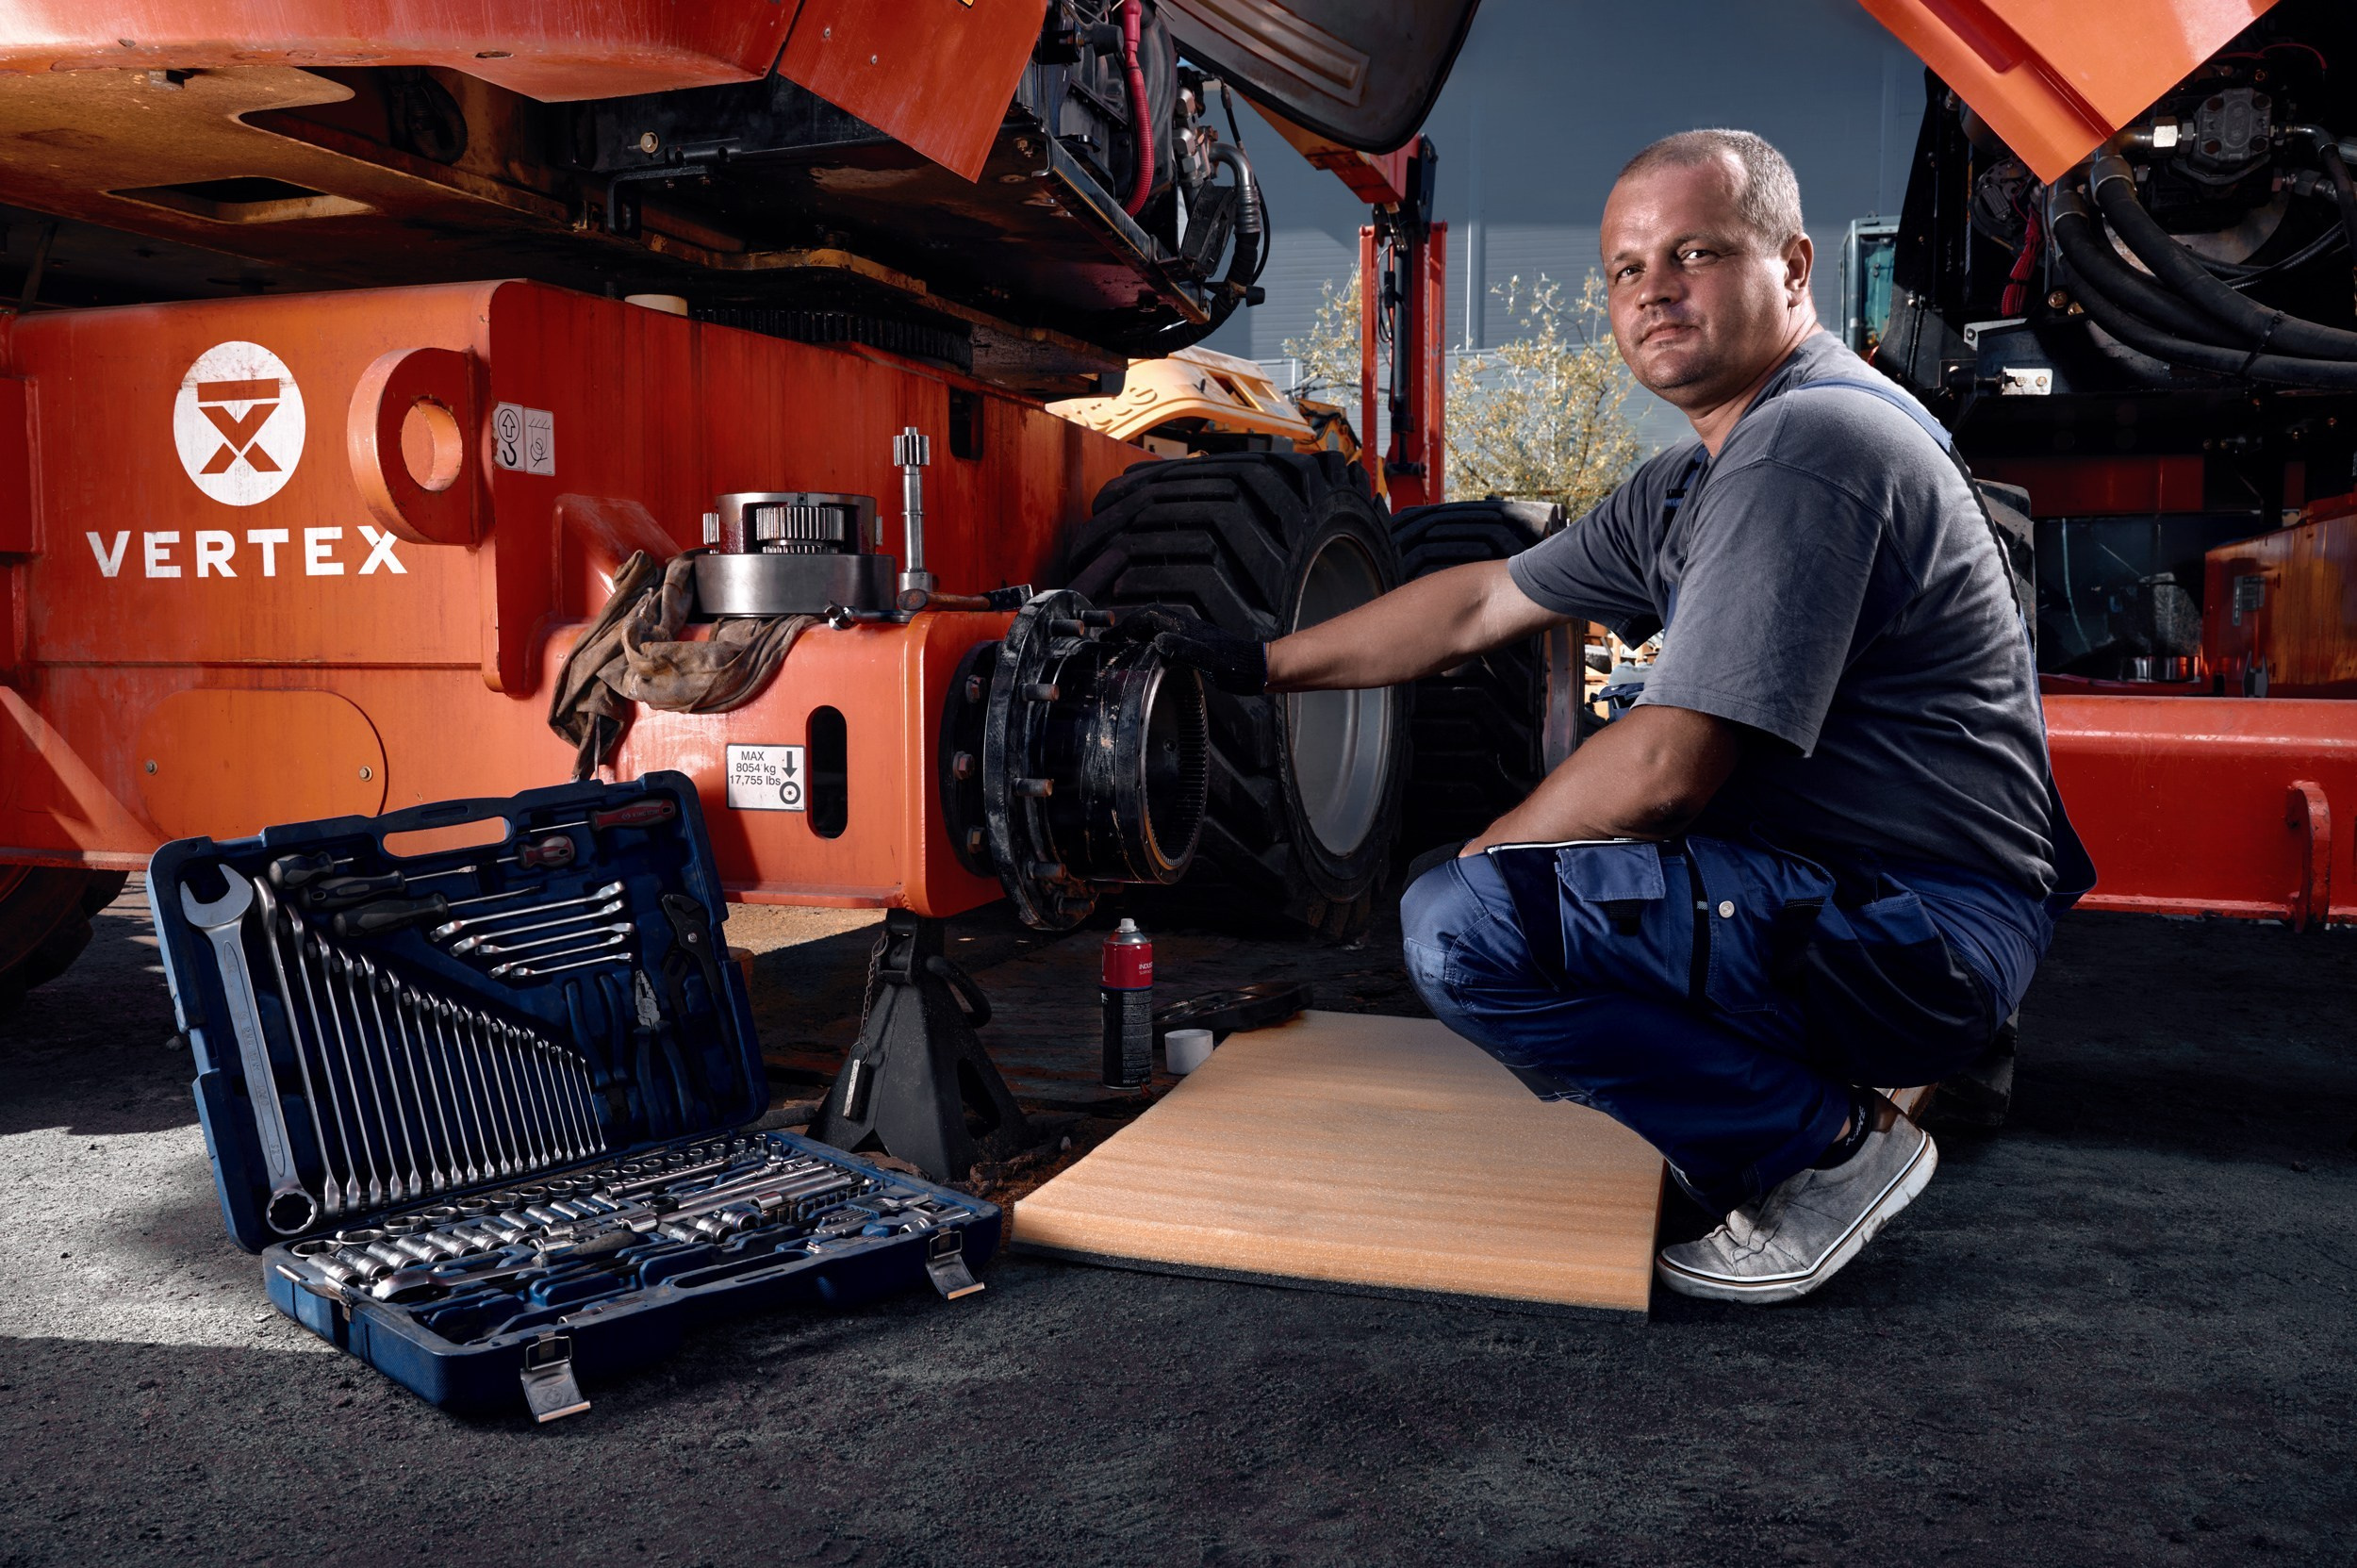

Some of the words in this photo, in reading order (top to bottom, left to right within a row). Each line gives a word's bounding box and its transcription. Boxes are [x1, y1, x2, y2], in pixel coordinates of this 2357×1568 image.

[85, 525, 408, 579] VERTEX
[741, 751, 765, 761] MAX
[735, 763, 761, 772] 8054
[764, 763, 776, 775] kg
[730, 775, 763, 785] 17,755
[766, 775, 782, 785] lbs
[1138, 961, 1153, 969] INDUS
